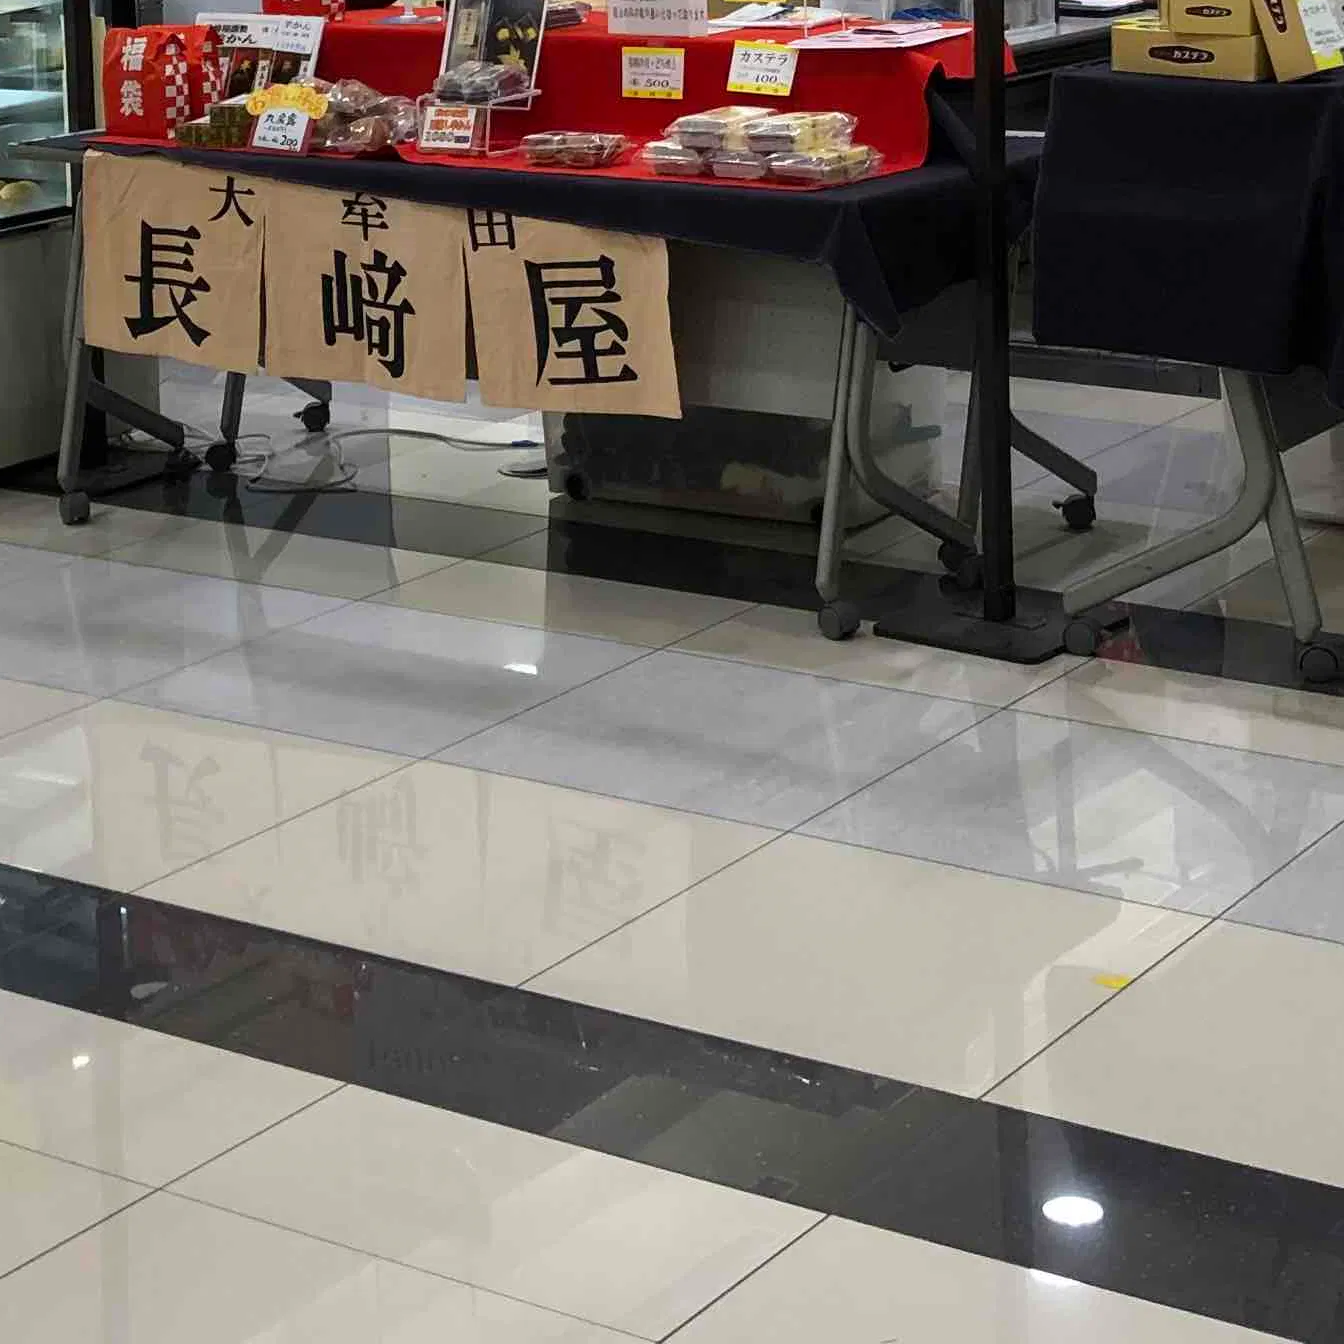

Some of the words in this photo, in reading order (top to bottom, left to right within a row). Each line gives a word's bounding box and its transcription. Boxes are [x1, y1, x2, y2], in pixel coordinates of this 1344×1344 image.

[119, 36, 146, 117] 福袋
[740, 51, 788, 66] カステラ
[208, 174, 517, 253] 大牟田
